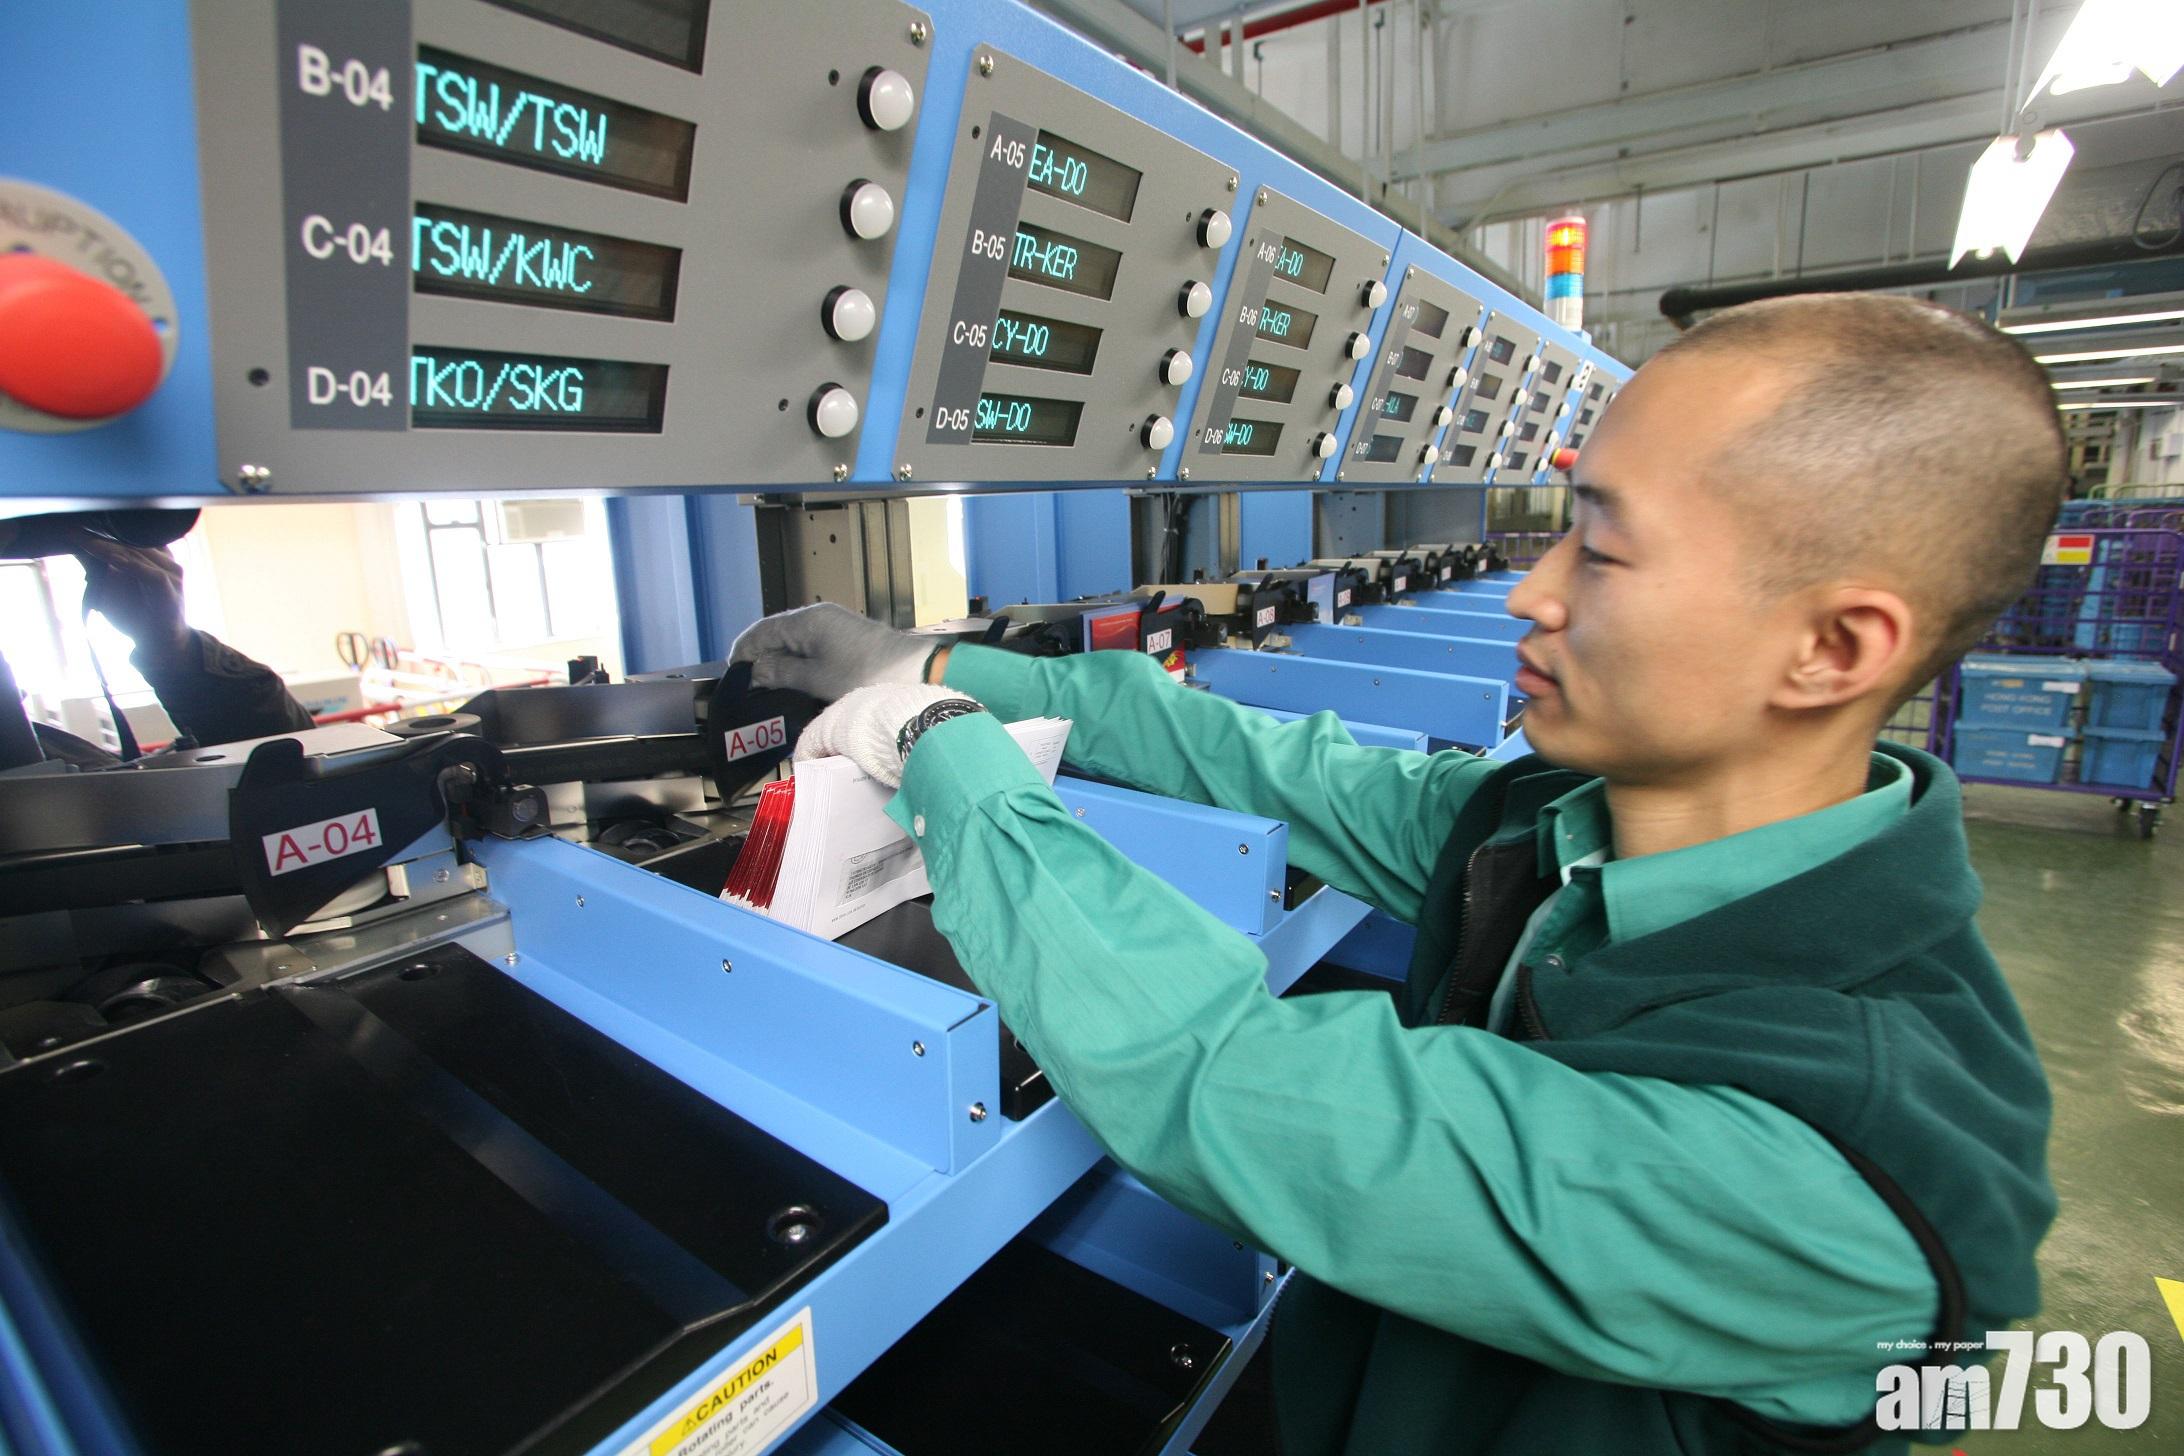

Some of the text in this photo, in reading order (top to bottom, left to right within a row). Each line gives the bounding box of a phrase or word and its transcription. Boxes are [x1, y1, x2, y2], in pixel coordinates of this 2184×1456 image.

[298, 45, 393, 111] B-04
[415, 61, 607, 165] TSW/TSW
[990, 135, 1026, 168] A-05
[1028, 143, 1088, 196] EA-DO
[302, 215, 393, 266] C-04
[972, 230, 1006, 261] B-05
[1012, 232, 1078, 280] TR-KER
[1257, 241, 1276, 264] A-06
[1275, 244, 1304, 277] A-DO
[1239, 305, 1258, 327] B-06
[953, 320, 987, 348] C-05
[992, 318, 1049, 356] CY-DO
[308, 366, 393, 406] D-04
[1222, 367, 1241, 387] C-06
[1241, 365, 1270, 391] Y-DO
[936, 407, 970, 431] D-05
[974, 399, 1032, 431] SW-DO
[1204, 427, 1224, 445] D-06
[1149, 631, 1171, 651] A-07
[730, 720, 784, 758] A-05
[275, 814, 376, 871] A-04
[696, 1348, 777, 1421] CAUTION
